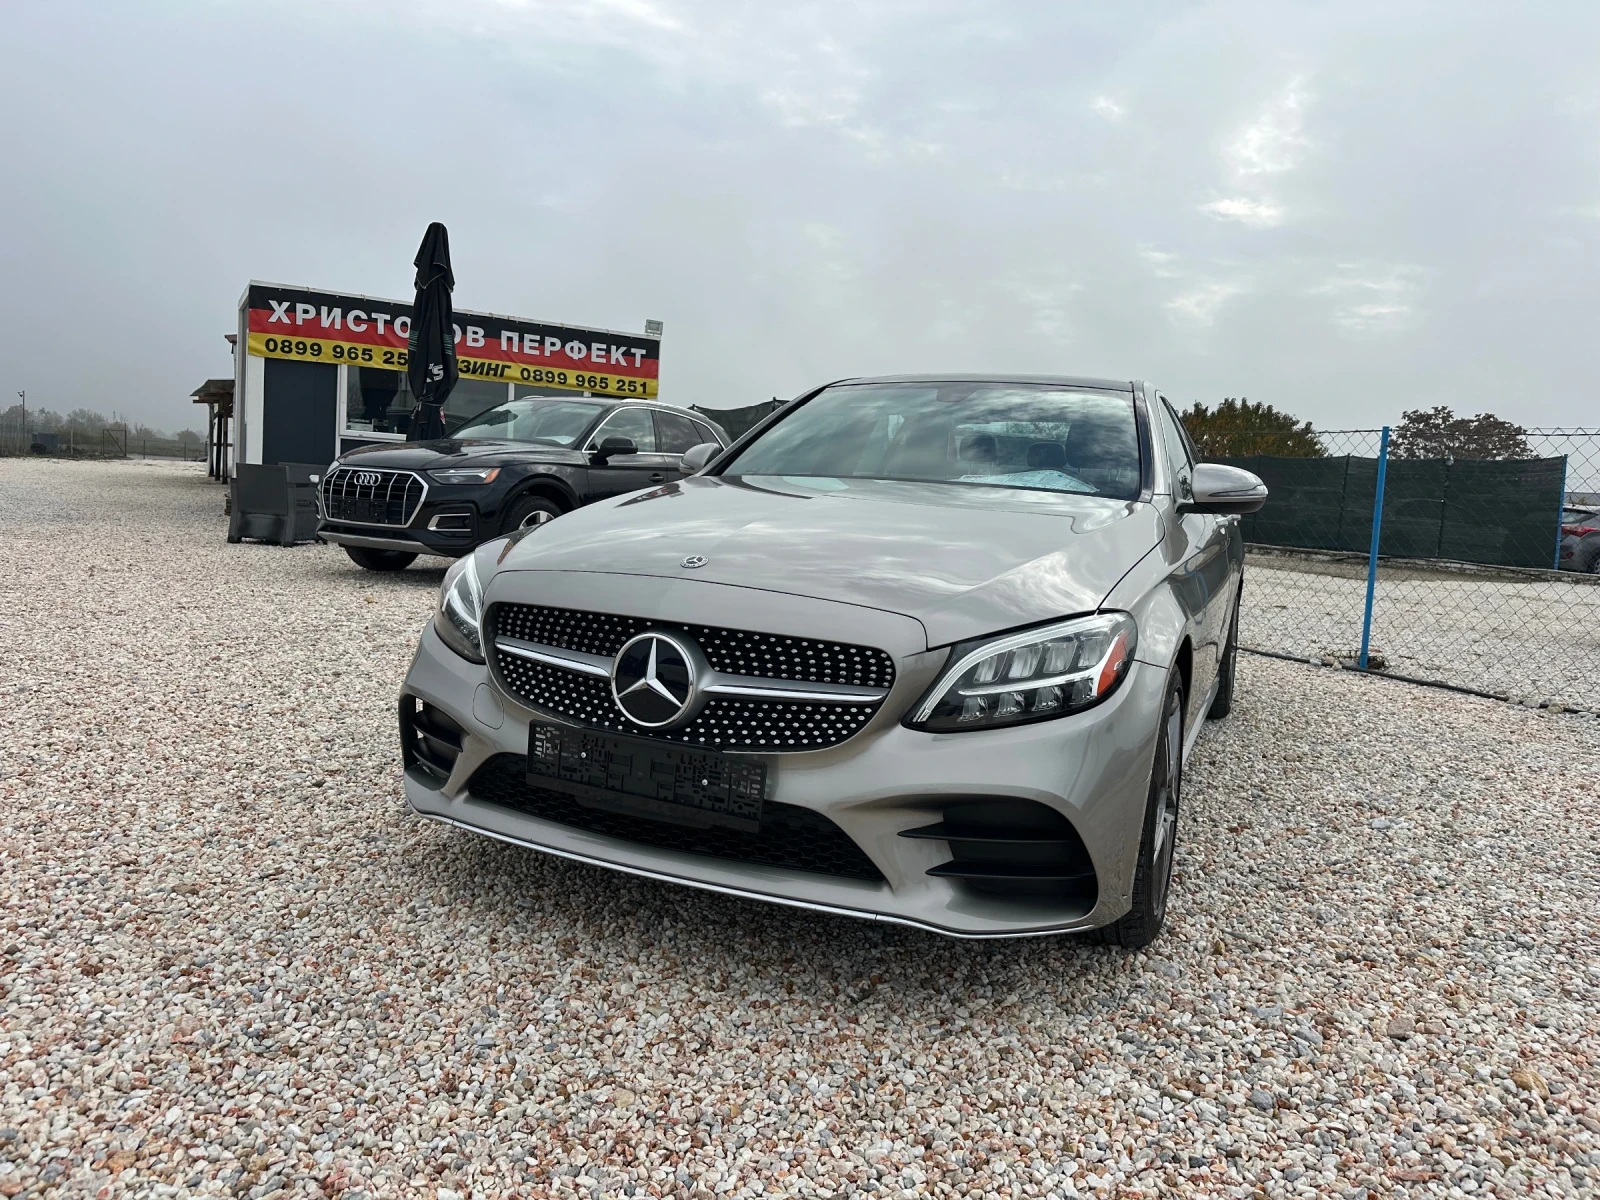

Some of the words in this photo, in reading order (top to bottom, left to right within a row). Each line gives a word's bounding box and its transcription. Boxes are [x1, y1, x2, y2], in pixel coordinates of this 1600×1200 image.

[265, 338, 322, 356] 0899
[332, 344, 373, 361] 965
[382, 351, 408, 366] 25
[457, 359, 512, 378] ЗИНГ
[520, 368, 568, 384] 0899
[575, 374, 609, 390] 965
[615, 379, 648, 394] 251
[501, 330, 646, 368] ПЕРФЕКТ
